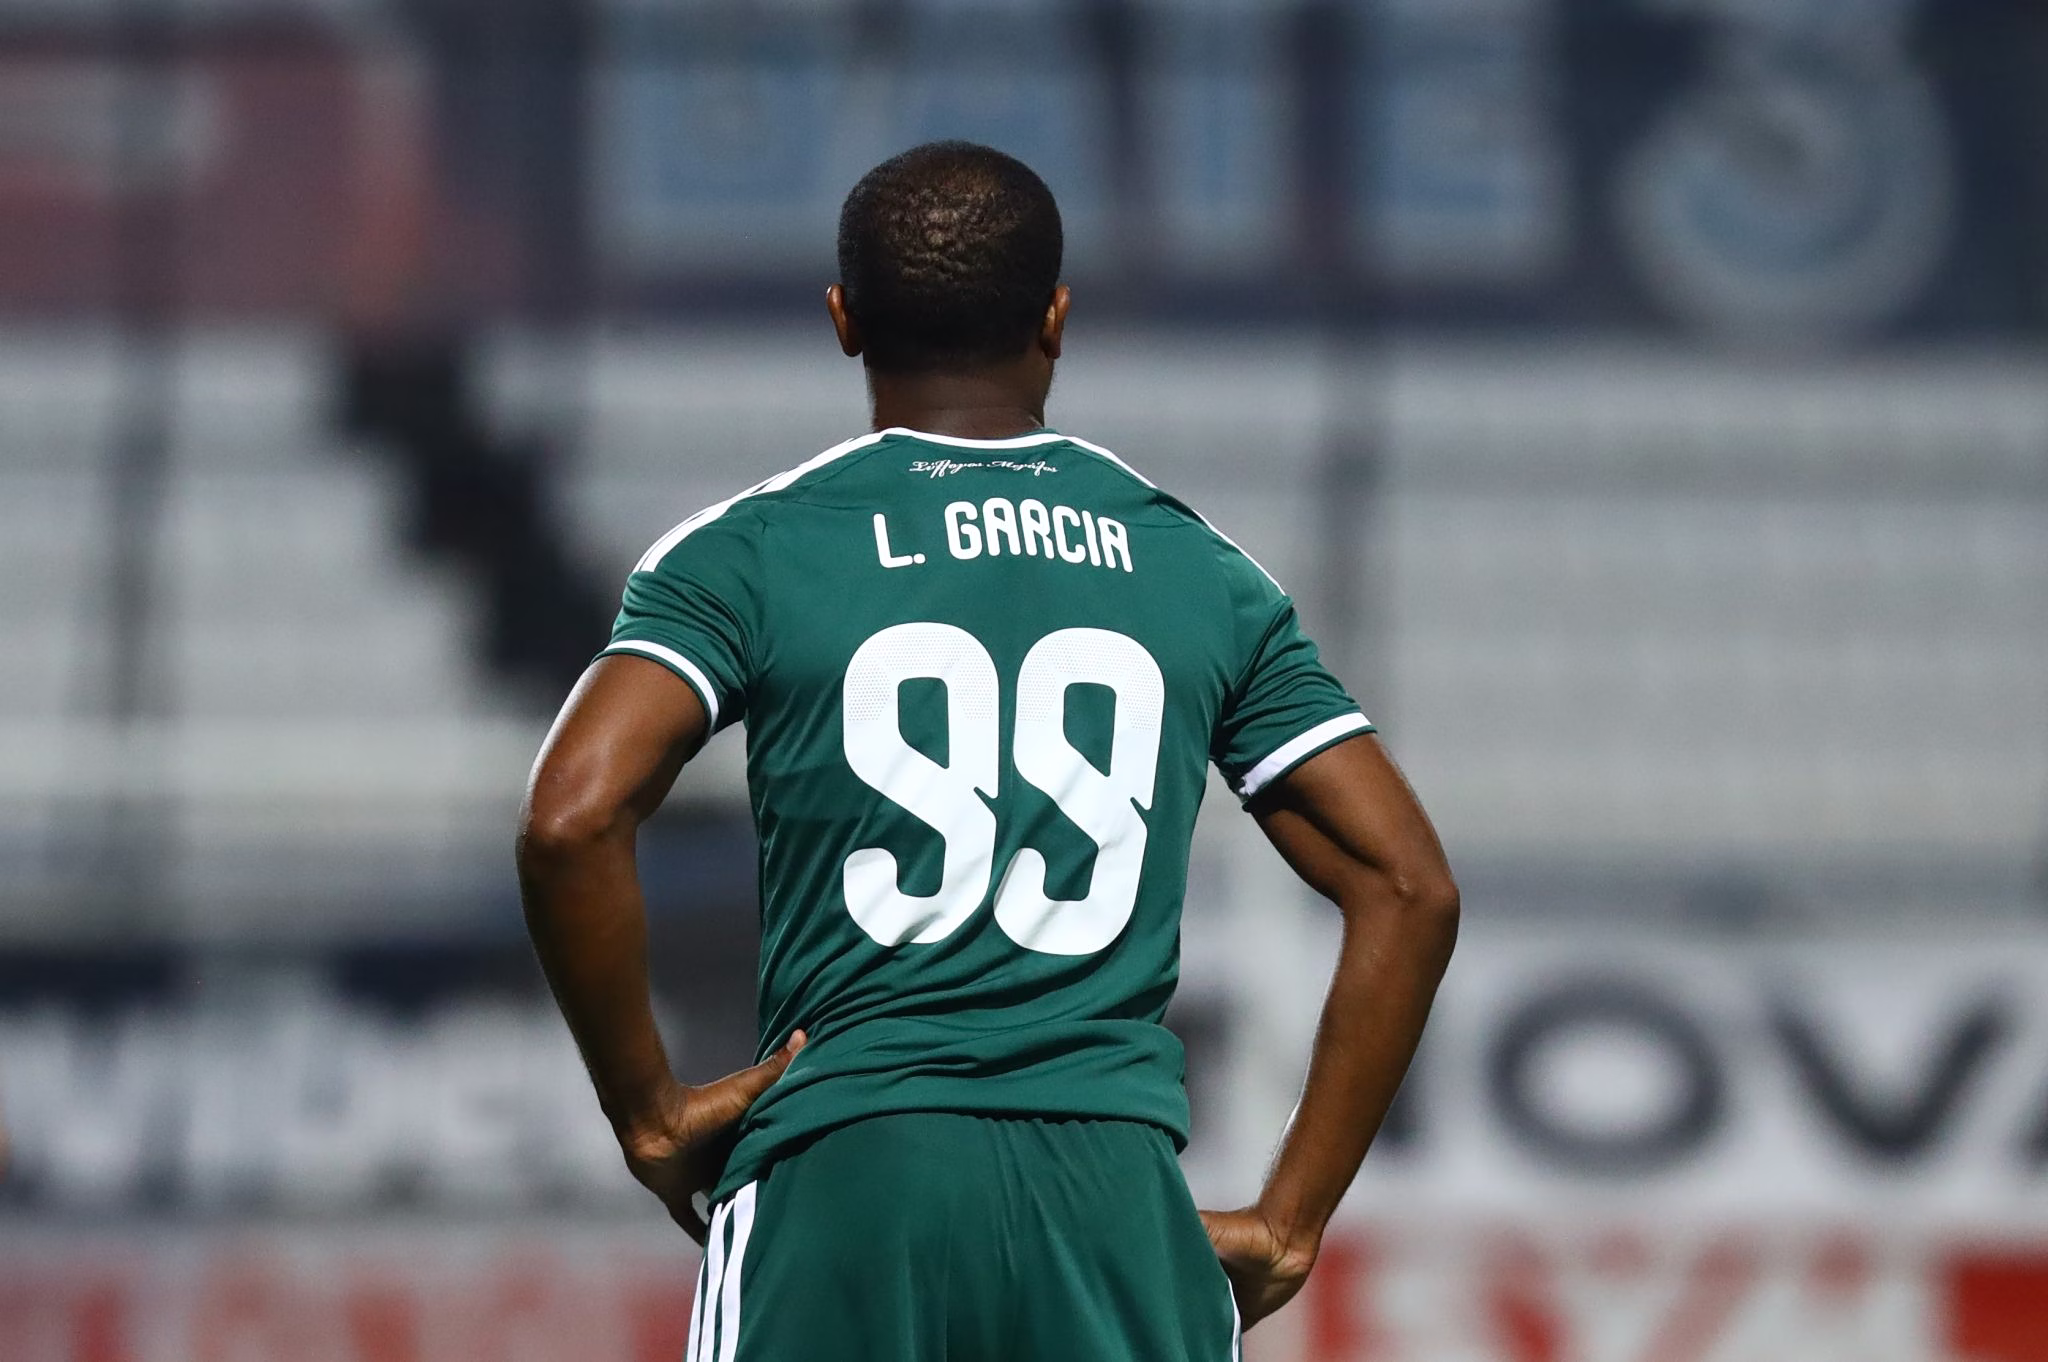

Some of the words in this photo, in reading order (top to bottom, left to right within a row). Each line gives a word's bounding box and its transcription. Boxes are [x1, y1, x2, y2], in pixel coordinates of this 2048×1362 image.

[873, 513, 926, 569] L.
[944, 497, 1134, 573] GARCIA
[842, 621, 1166, 956] 99
